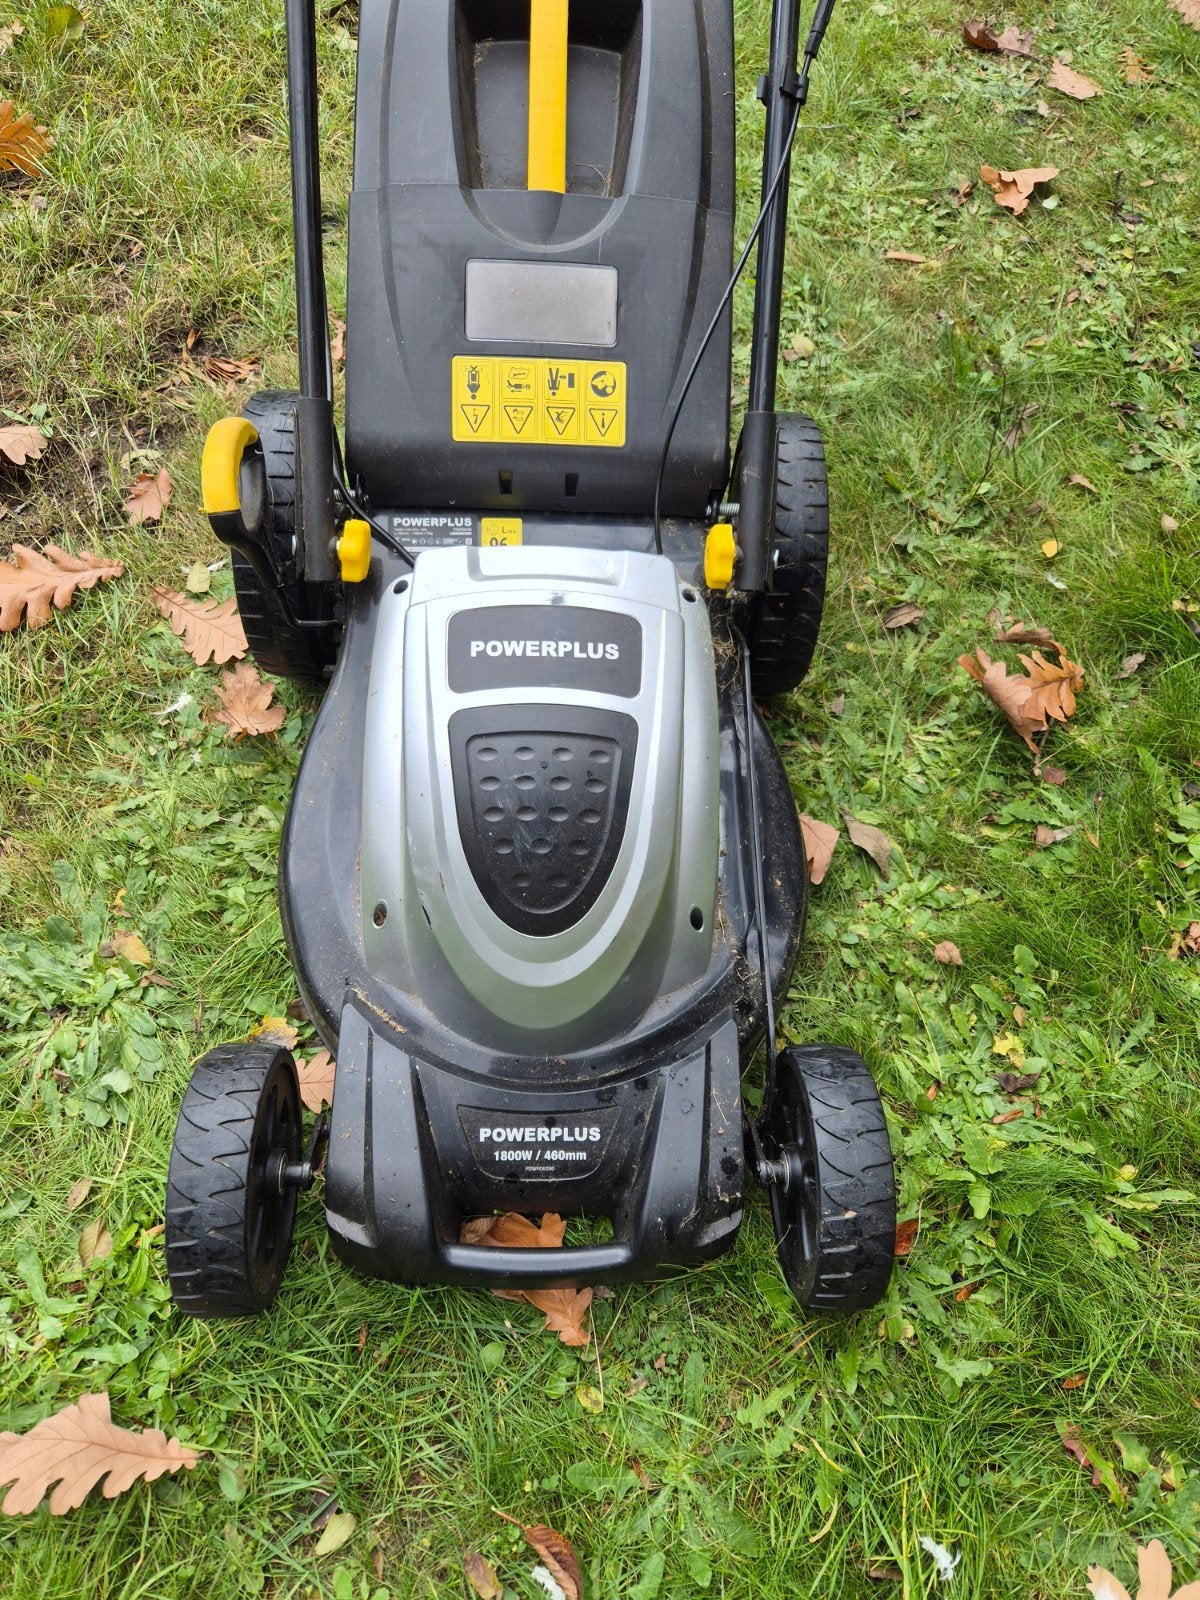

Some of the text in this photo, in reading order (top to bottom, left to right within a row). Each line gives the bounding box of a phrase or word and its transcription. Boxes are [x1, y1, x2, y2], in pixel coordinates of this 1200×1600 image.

[393, 517, 472, 527] POWERPLUS
[470, 640, 620, 660] POWERPLUS
[479, 1127, 601, 1142] POWERPLUS
[494, 1150, 587, 1161] 1800W / 460mm
